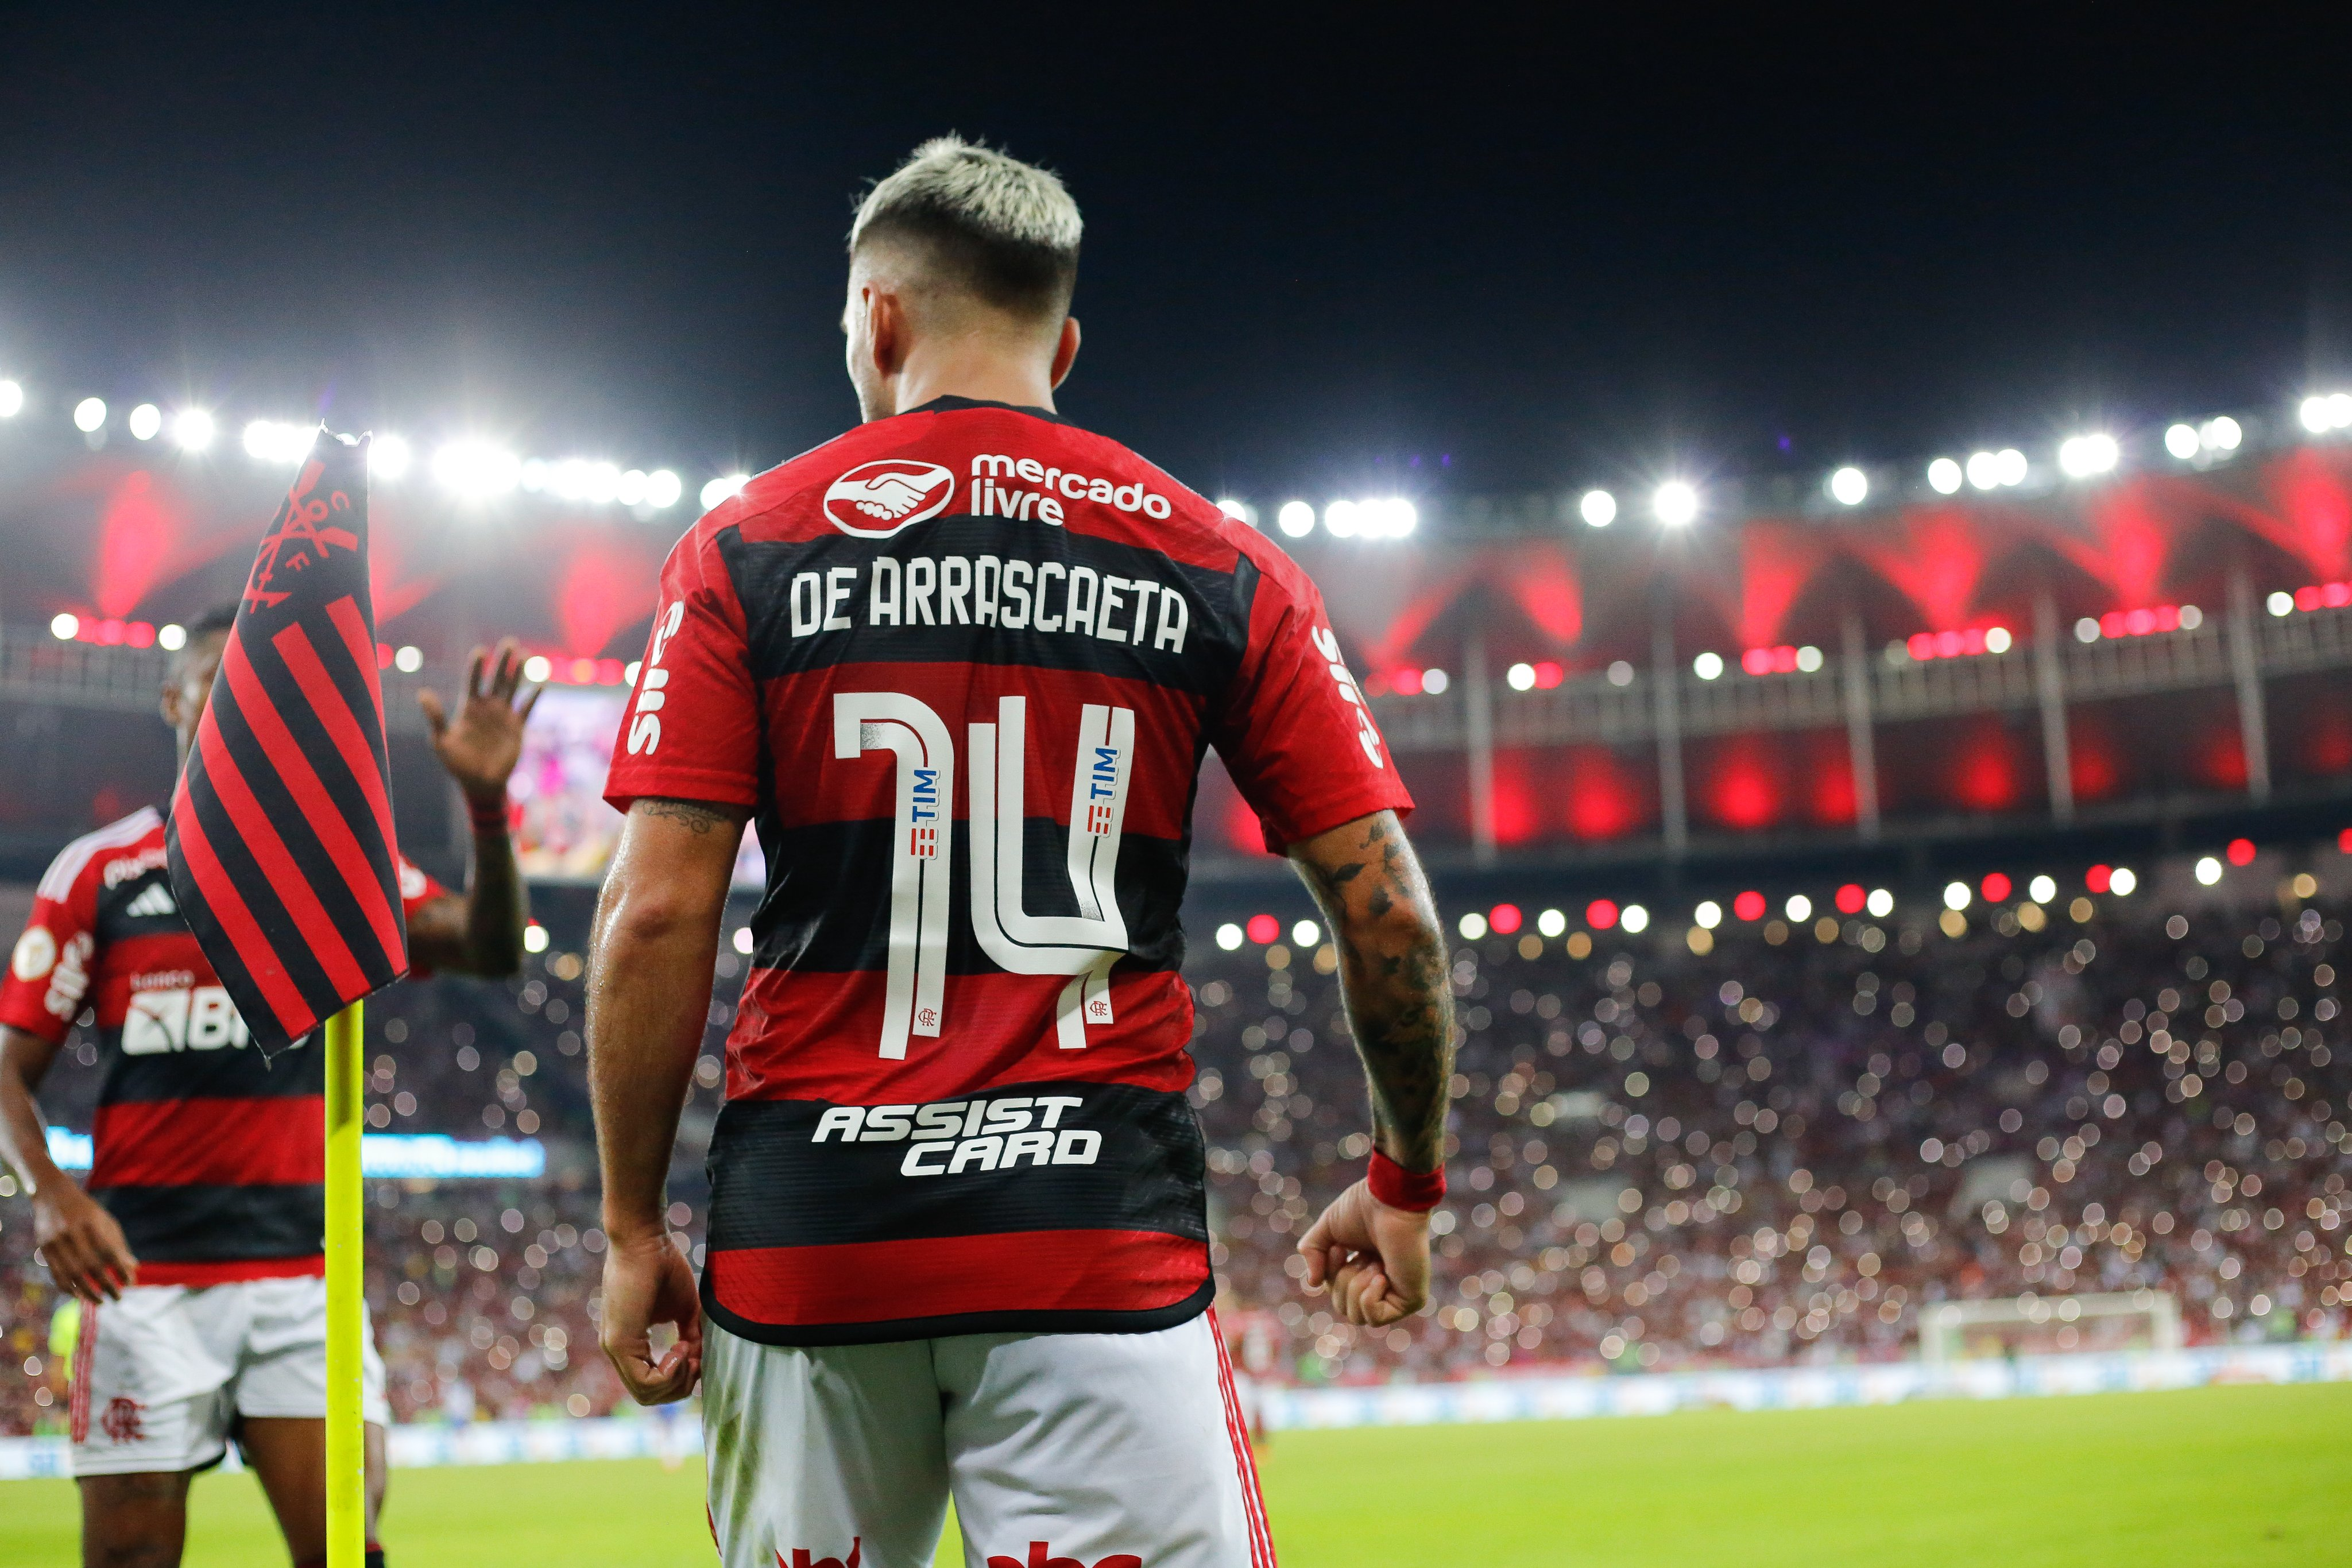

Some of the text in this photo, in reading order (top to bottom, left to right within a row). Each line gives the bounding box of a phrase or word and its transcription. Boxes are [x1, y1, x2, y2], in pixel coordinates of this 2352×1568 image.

[971, 454, 1171, 520] mercado
[971, 478, 1064, 526] livre
[791, 555, 1189, 654] DE ARRASCAETA
[912, 768, 938, 823] TIM
[1090, 747, 1118, 800] TIM
[833, 691, 1135, 1060] 14
[811, 1096, 1084, 1143] ASSIST
[900, 1129, 1102, 1177] CARD
